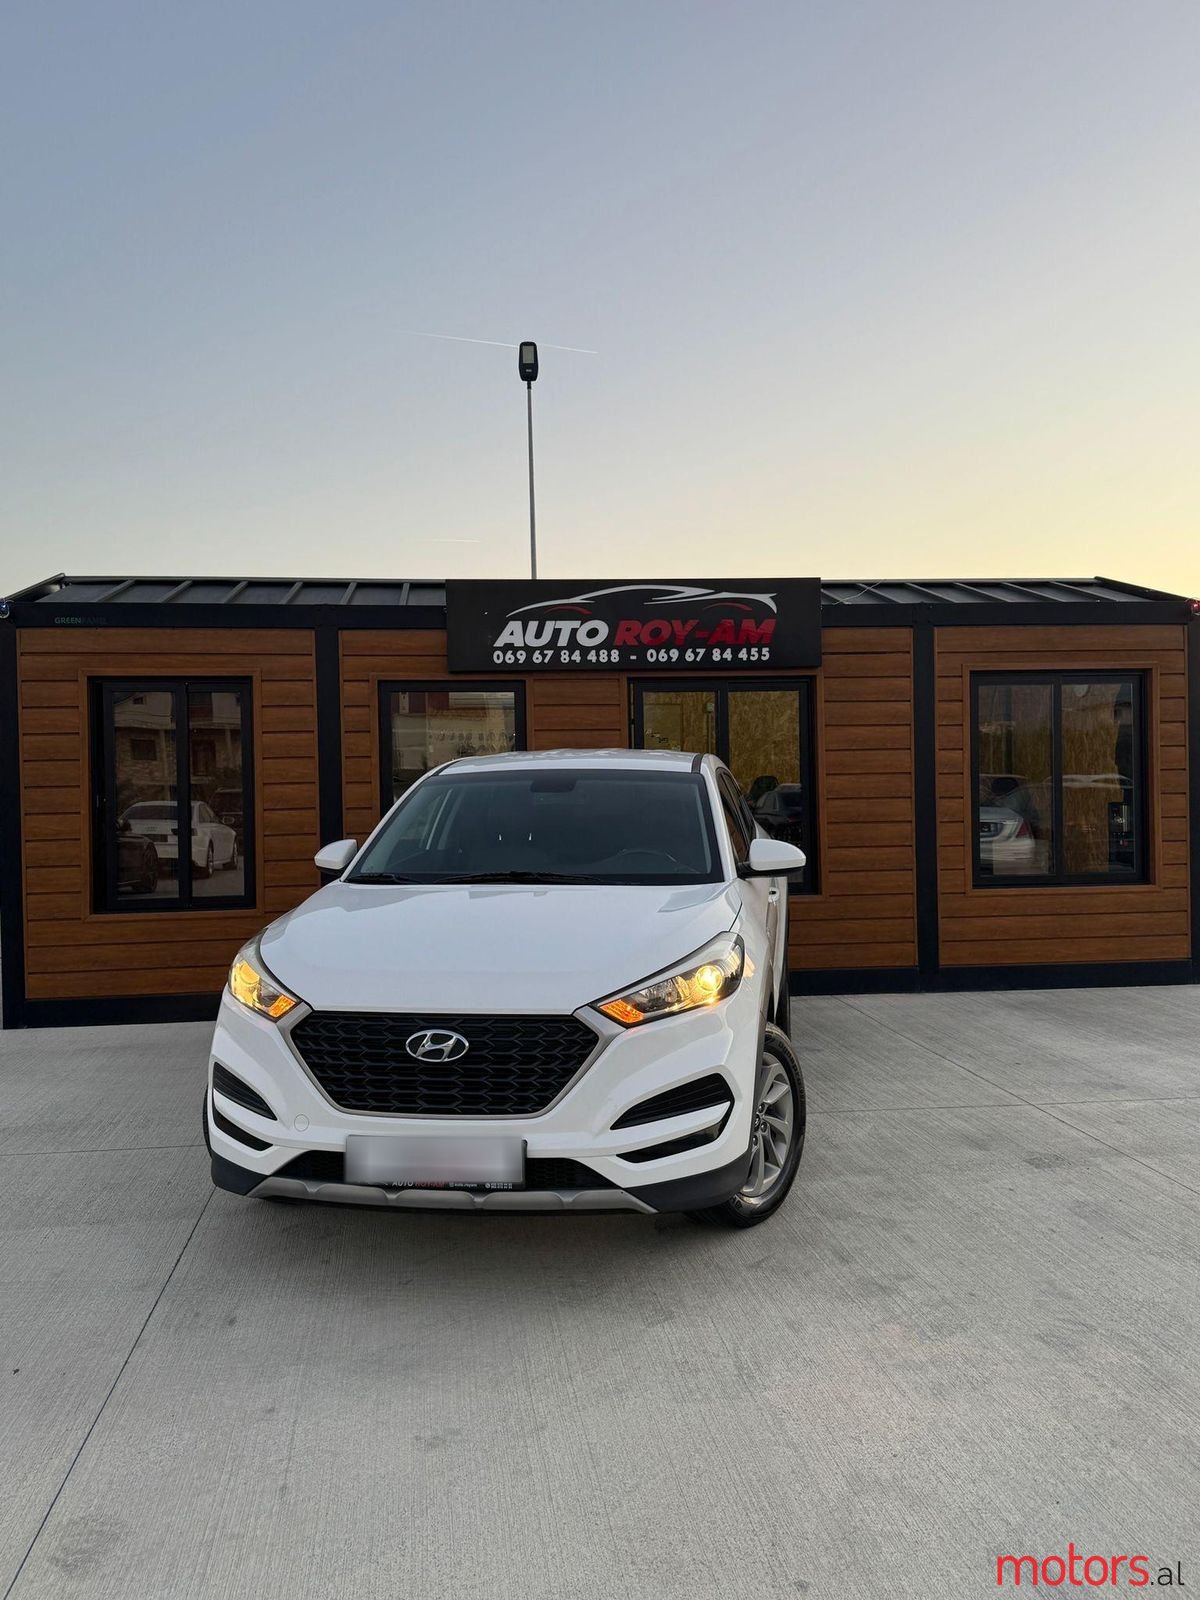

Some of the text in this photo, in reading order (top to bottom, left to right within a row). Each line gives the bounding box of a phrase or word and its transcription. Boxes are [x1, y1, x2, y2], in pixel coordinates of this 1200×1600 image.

[493, 618, 777, 647] AUTO ROY-AM
[493, 650, 526, 664] 069
[532, 650, 554, 664] 67
[560, 650, 581, 663] 84
[587, 649, 620, 663] 488
[646, 648, 679, 662] 069
[685, 648, 706, 662] 67
[712, 648, 733, 661] 84
[738, 647, 770, 661] 455
